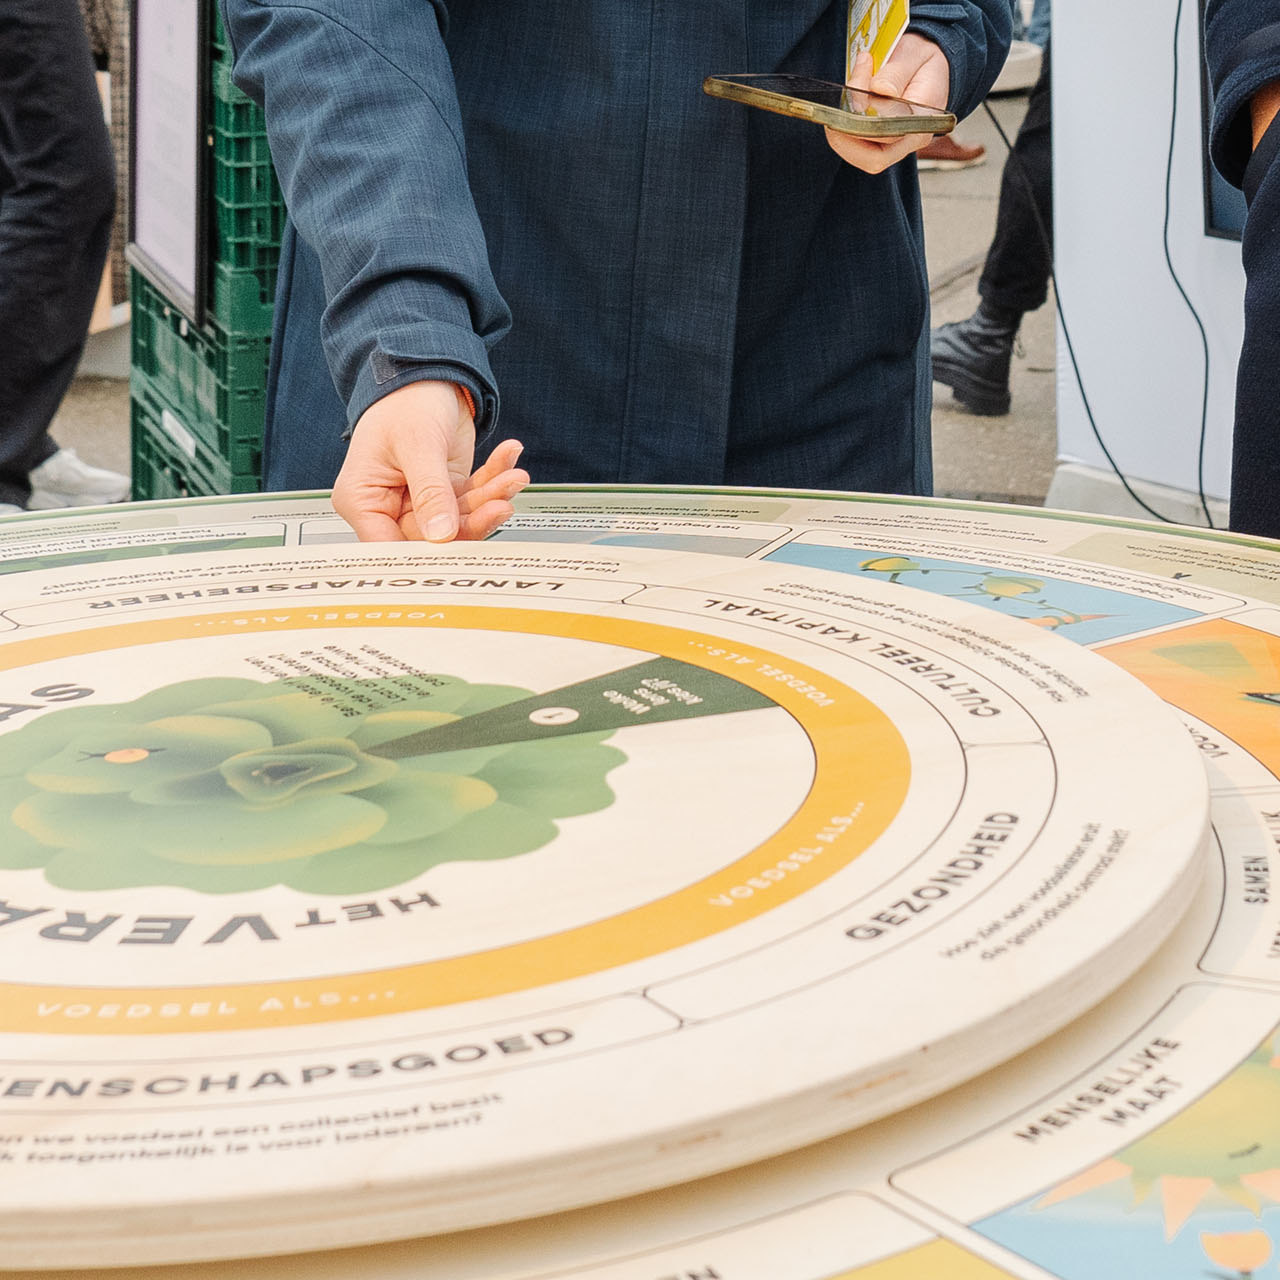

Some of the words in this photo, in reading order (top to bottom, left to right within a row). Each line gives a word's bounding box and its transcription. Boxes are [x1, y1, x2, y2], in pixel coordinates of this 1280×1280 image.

[89, 578, 565, 609] LANDSCHAPSBEHEER
[704, 599, 870, 643] KAPITAAL
[869, 642, 1001, 717] CULTUREEL
[845, 813, 1019, 940] GEZONDHEID
[1243, 857, 1269, 904] SAMEN
[295, 892, 443, 928] HET
[37, 1001, 236, 1018] VOEDSEL
[259, 989, 395, 1012] ALS...
[1015, 1038, 1180, 1142] MENSELIJKE
[1102, 1076, 1180, 1125] MAAT
